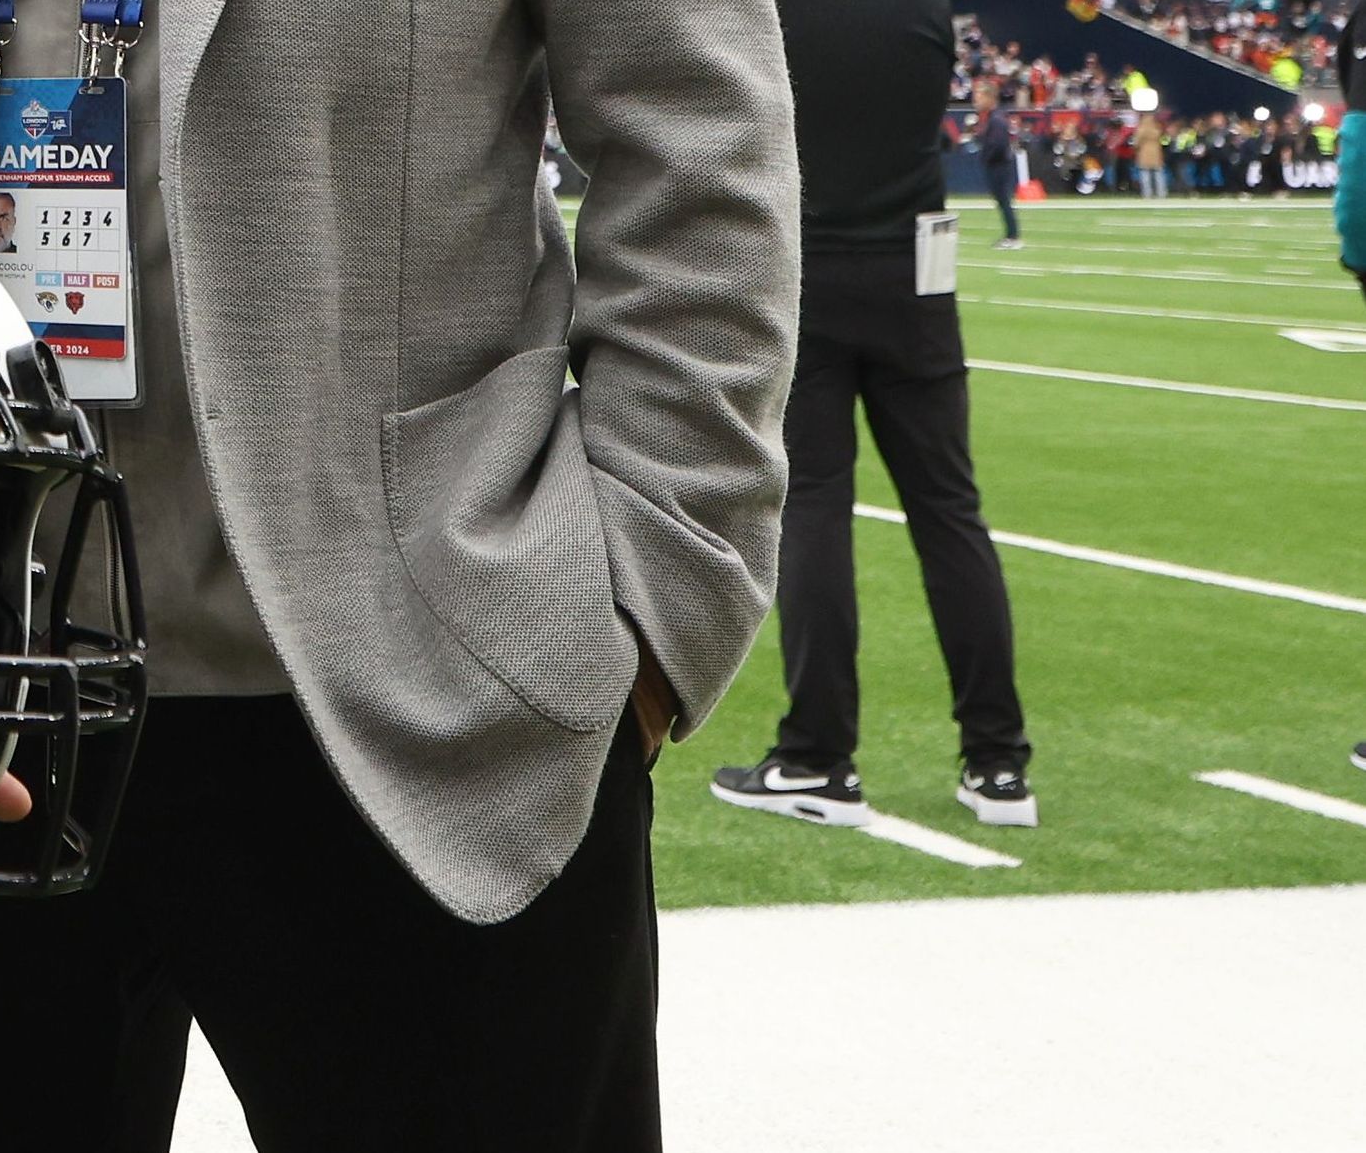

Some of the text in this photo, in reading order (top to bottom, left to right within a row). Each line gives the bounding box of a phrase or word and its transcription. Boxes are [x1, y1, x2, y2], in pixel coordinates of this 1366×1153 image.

[24, 173, 54, 182] HOTSPUR
[55, 174, 83, 183] STADIUM
[84, 174, 110, 183] ACCESS
[41, 210, 112, 227] 1 2 3 4
[41, 231, 92, 247] 5 6 7
[67, 276, 87, 286] HALF
[96, 276, 116, 287] POST
[66, 345, 90, 355] 2024
